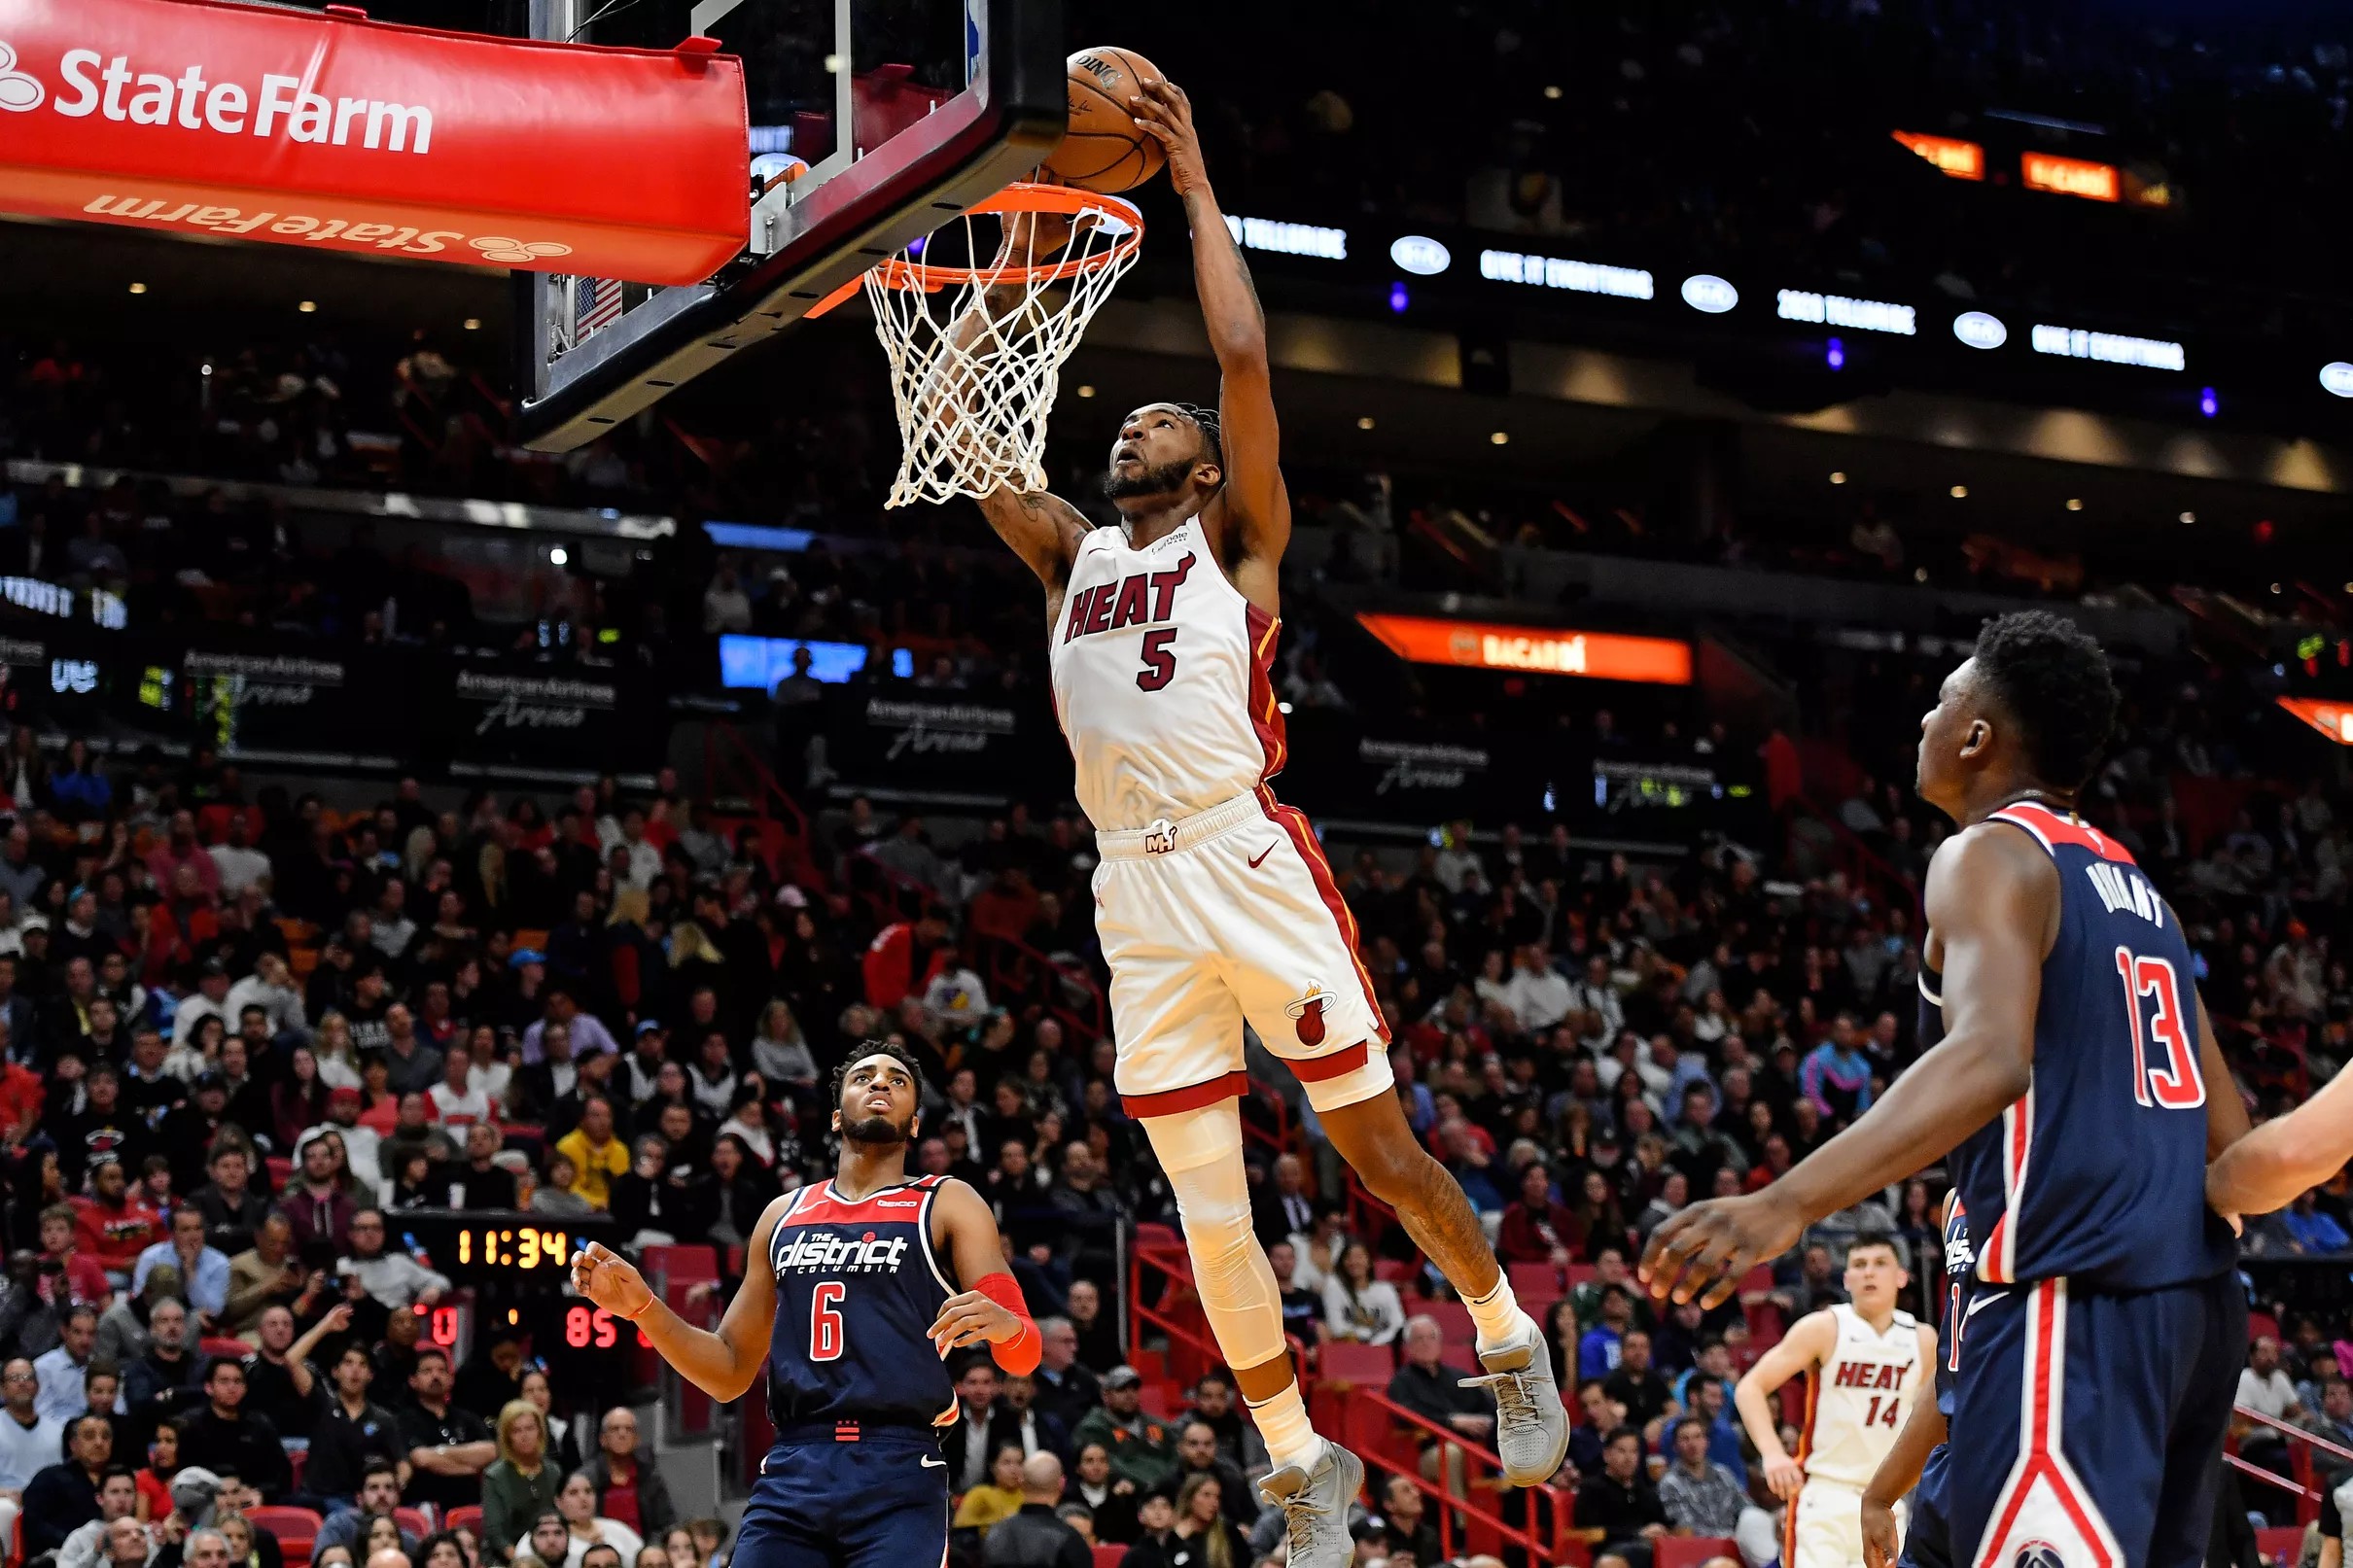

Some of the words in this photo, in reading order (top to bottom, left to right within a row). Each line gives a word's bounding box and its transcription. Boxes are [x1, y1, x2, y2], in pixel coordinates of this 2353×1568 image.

[1063, 550, 1197, 645] HEAT
[1136, 627, 1178, 692] 5
[2116, 945, 2206, 1109] 13
[459, 1228, 566, 1269] 11:34
[776, 1230, 909, 1272] district
[811, 1233, 834, 1242] THE
[797, 1266, 897, 1274] COLUMBIA
[566, 1307, 616, 1347] 85
[809, 1281, 846, 1362] 6
[1835, 1358, 1914, 1391] HEAT
[1866, 1396, 1900, 1429] 14
